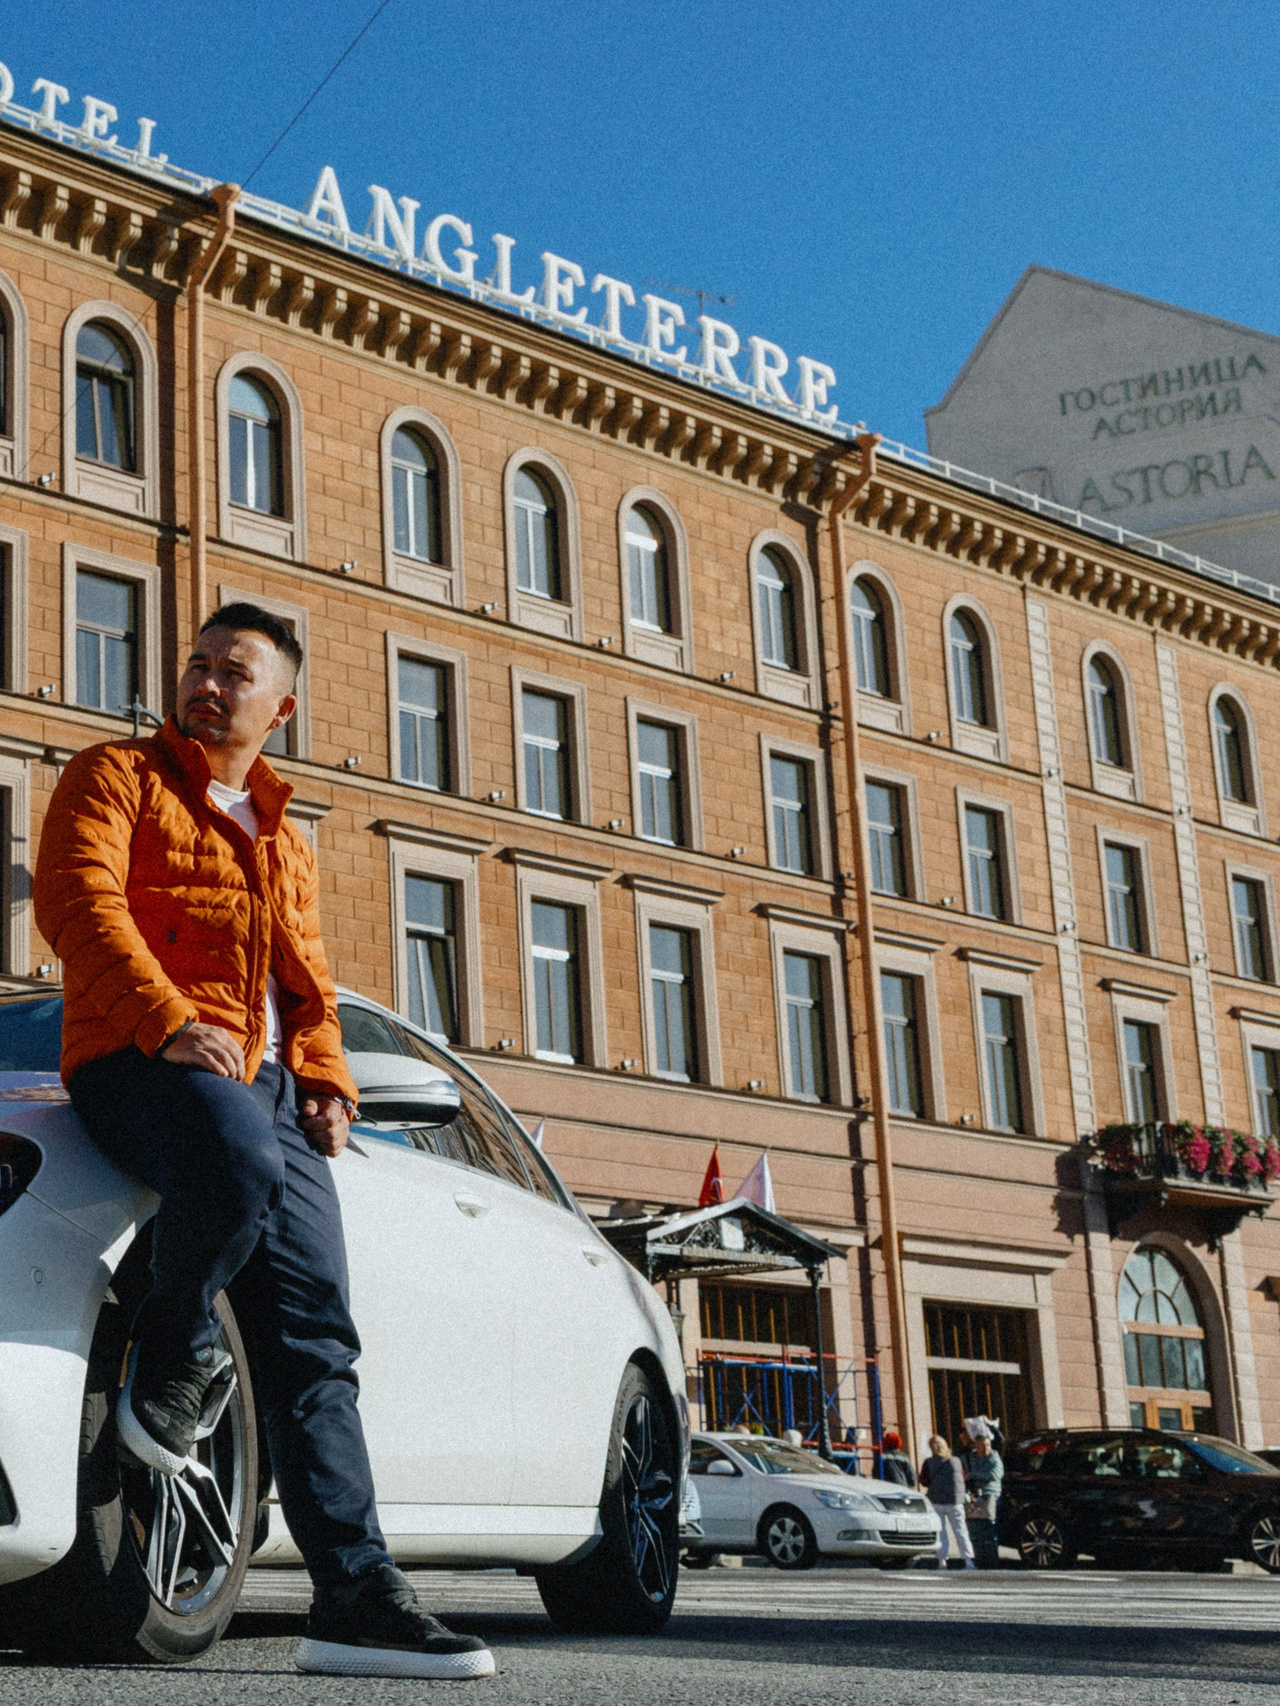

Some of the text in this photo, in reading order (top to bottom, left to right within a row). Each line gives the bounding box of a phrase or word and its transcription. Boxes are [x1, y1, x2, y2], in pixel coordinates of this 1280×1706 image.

[306, 165, 839, 421] ANGLETERRE
[1058, 352, 1269, 417] ГОСТИНИЦА
[1091, 387, 1243, 441] АСТОРИЯ
[1078, 444, 1277, 513] ASTORIA
